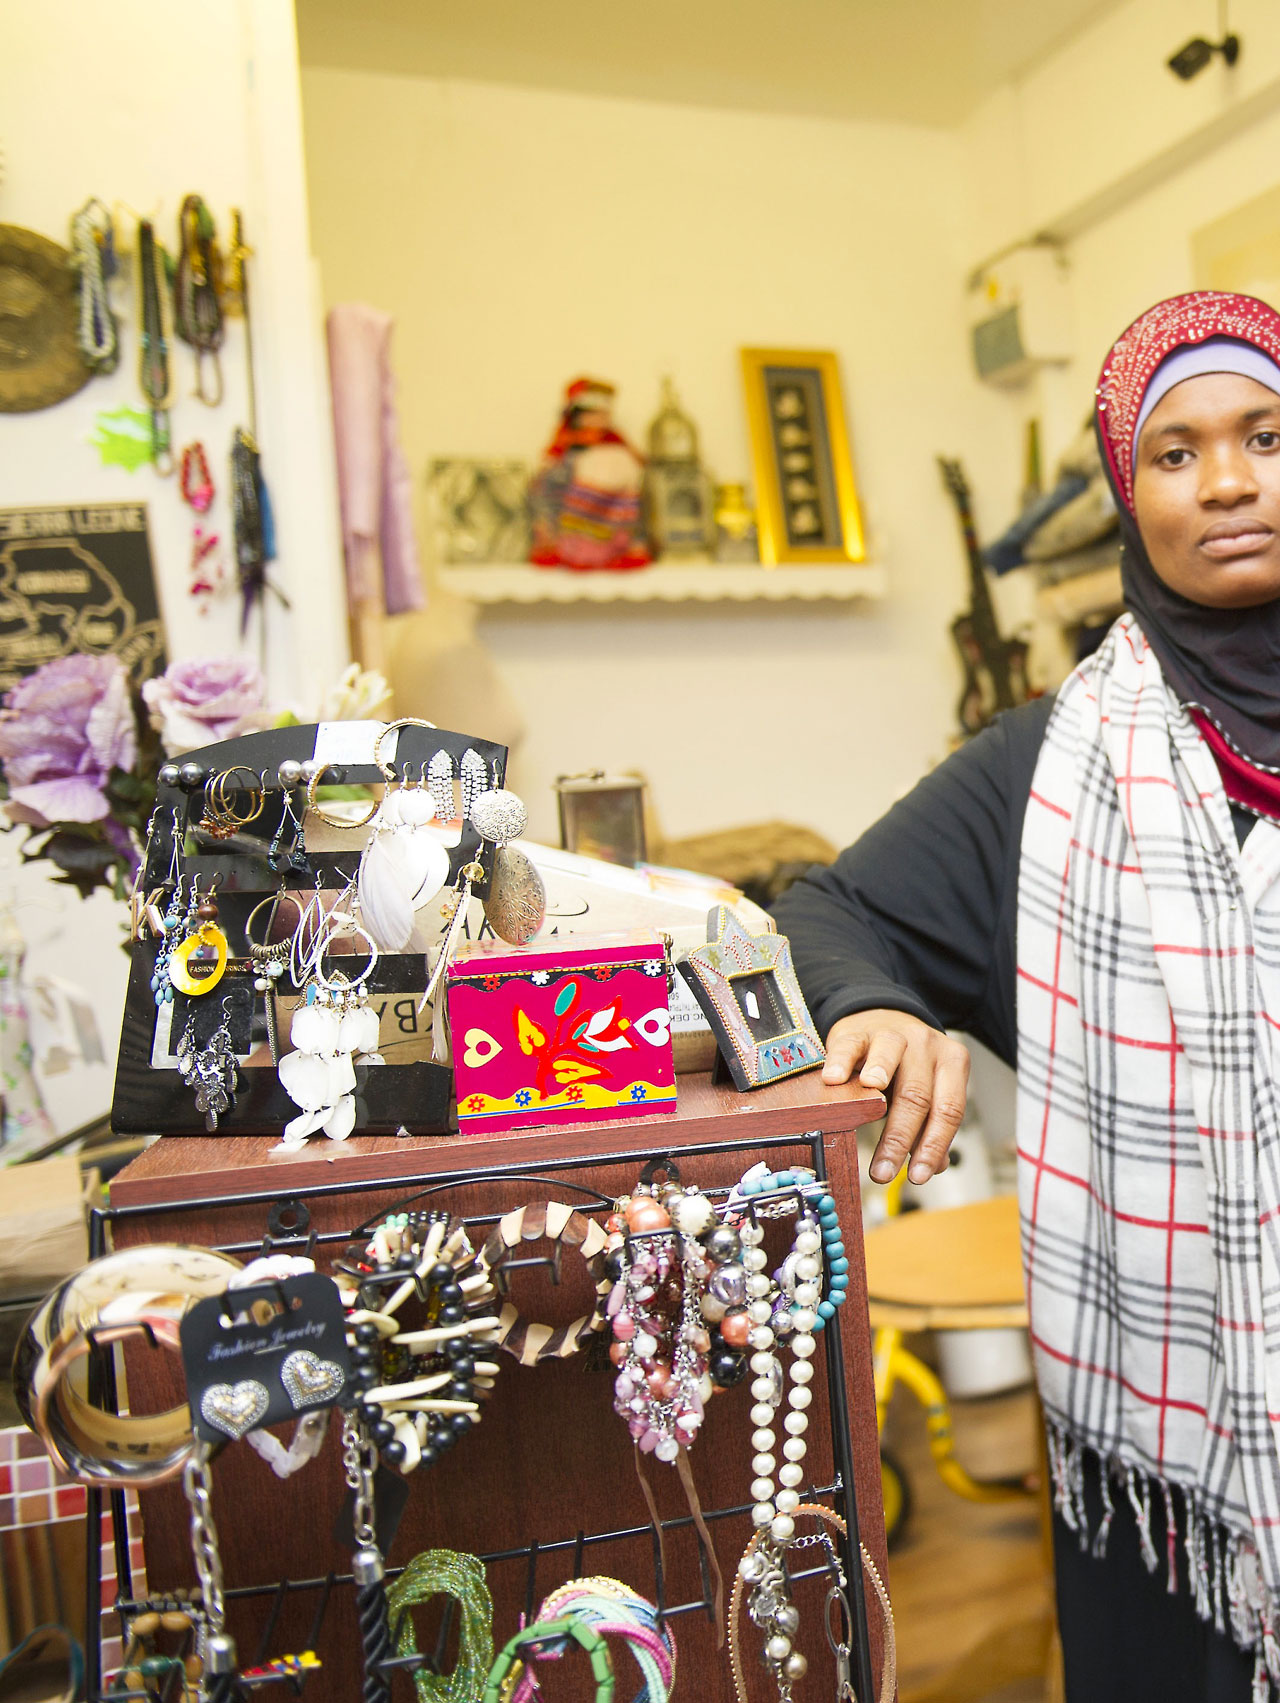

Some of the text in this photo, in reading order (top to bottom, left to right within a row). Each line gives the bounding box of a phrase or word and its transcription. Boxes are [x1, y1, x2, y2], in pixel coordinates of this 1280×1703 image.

[189, 965, 218, 973] FASHION
[207, 1320, 327, 1361] Fashion Jewelry
